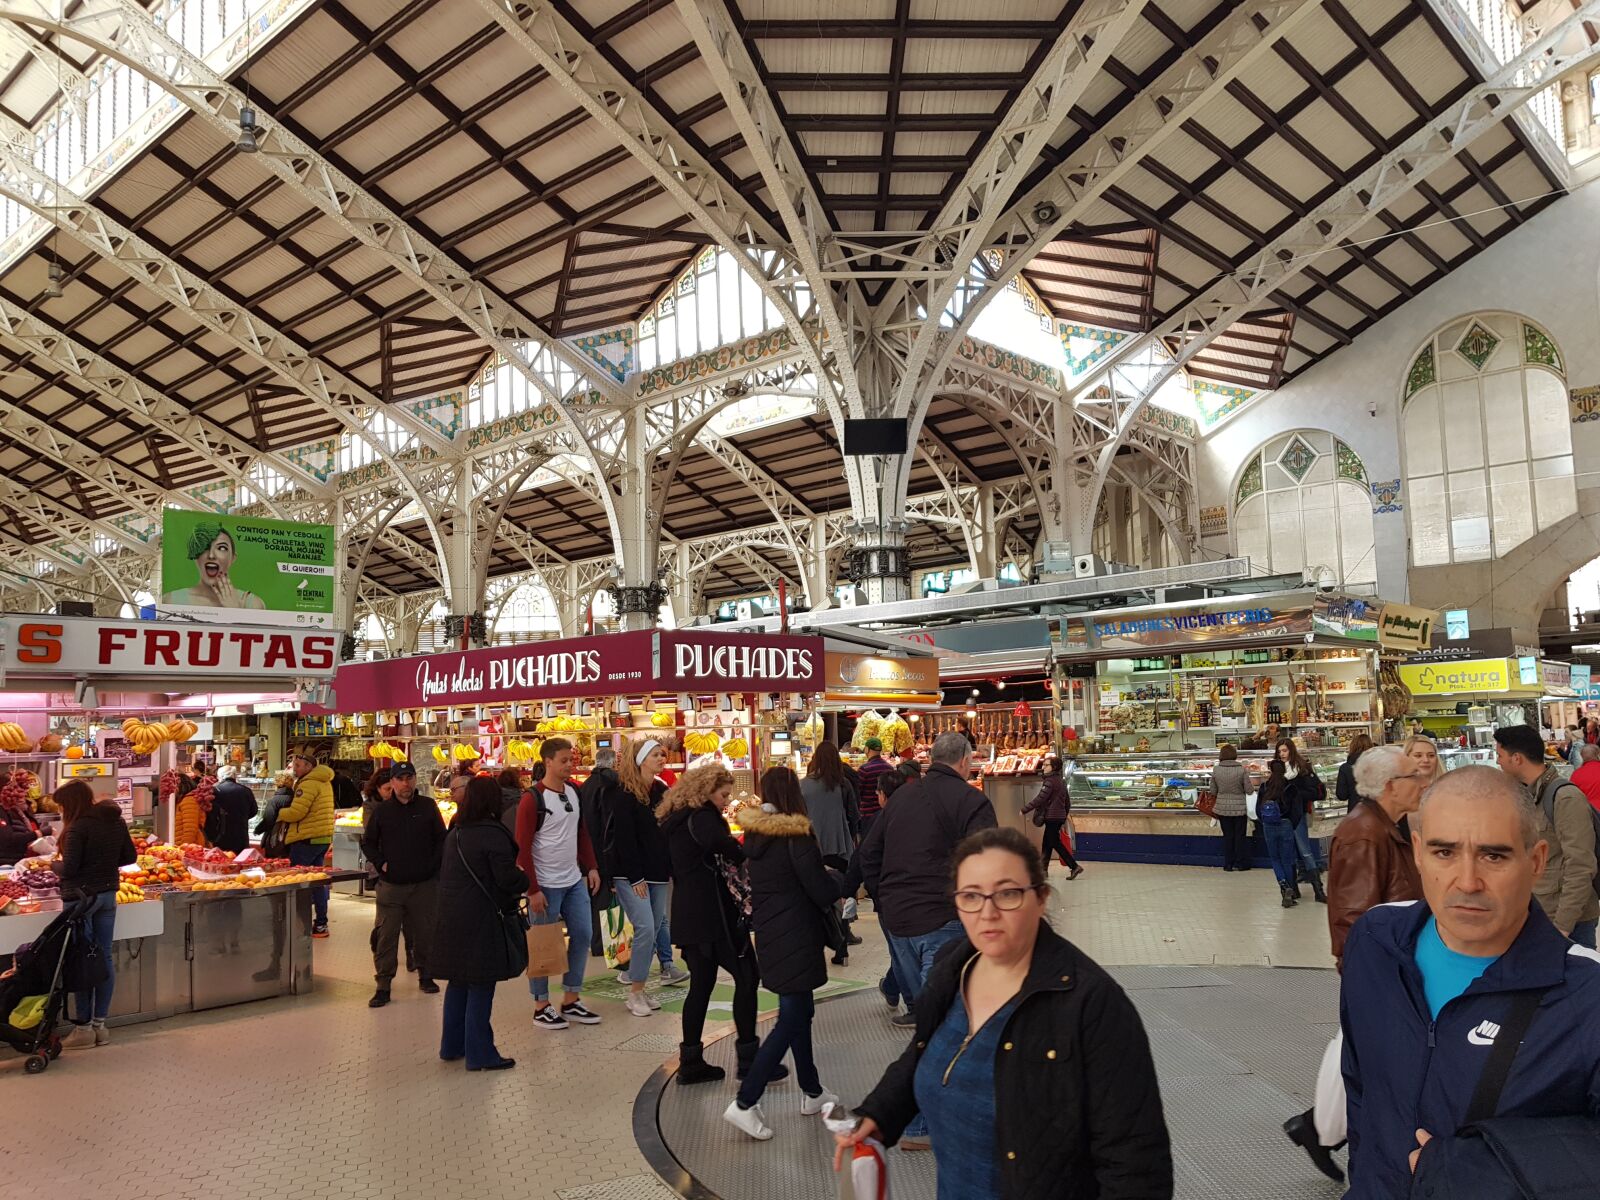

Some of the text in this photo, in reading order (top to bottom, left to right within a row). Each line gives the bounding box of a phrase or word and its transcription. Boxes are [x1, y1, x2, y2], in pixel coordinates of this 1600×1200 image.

[236, 526, 269, 535] CONTIGO
[281, 564, 325, 574] SÍ, QUIERO!!!
[303, 589, 324, 598] CENTRAL
[1174, 612, 1226, 630] VICENT
[1226, 607, 1272, 625] PERIS
[98, 627, 335, 669] FRUTAS
[675, 643, 813, 679] PUCHADES
[416, 660, 449, 702] Frutas
[451, 656, 484, 693] selectas
[489, 650, 601, 690] PUCHADES
[628, 671, 642, 679] 1930
[1436, 671, 1500, 684] natura
